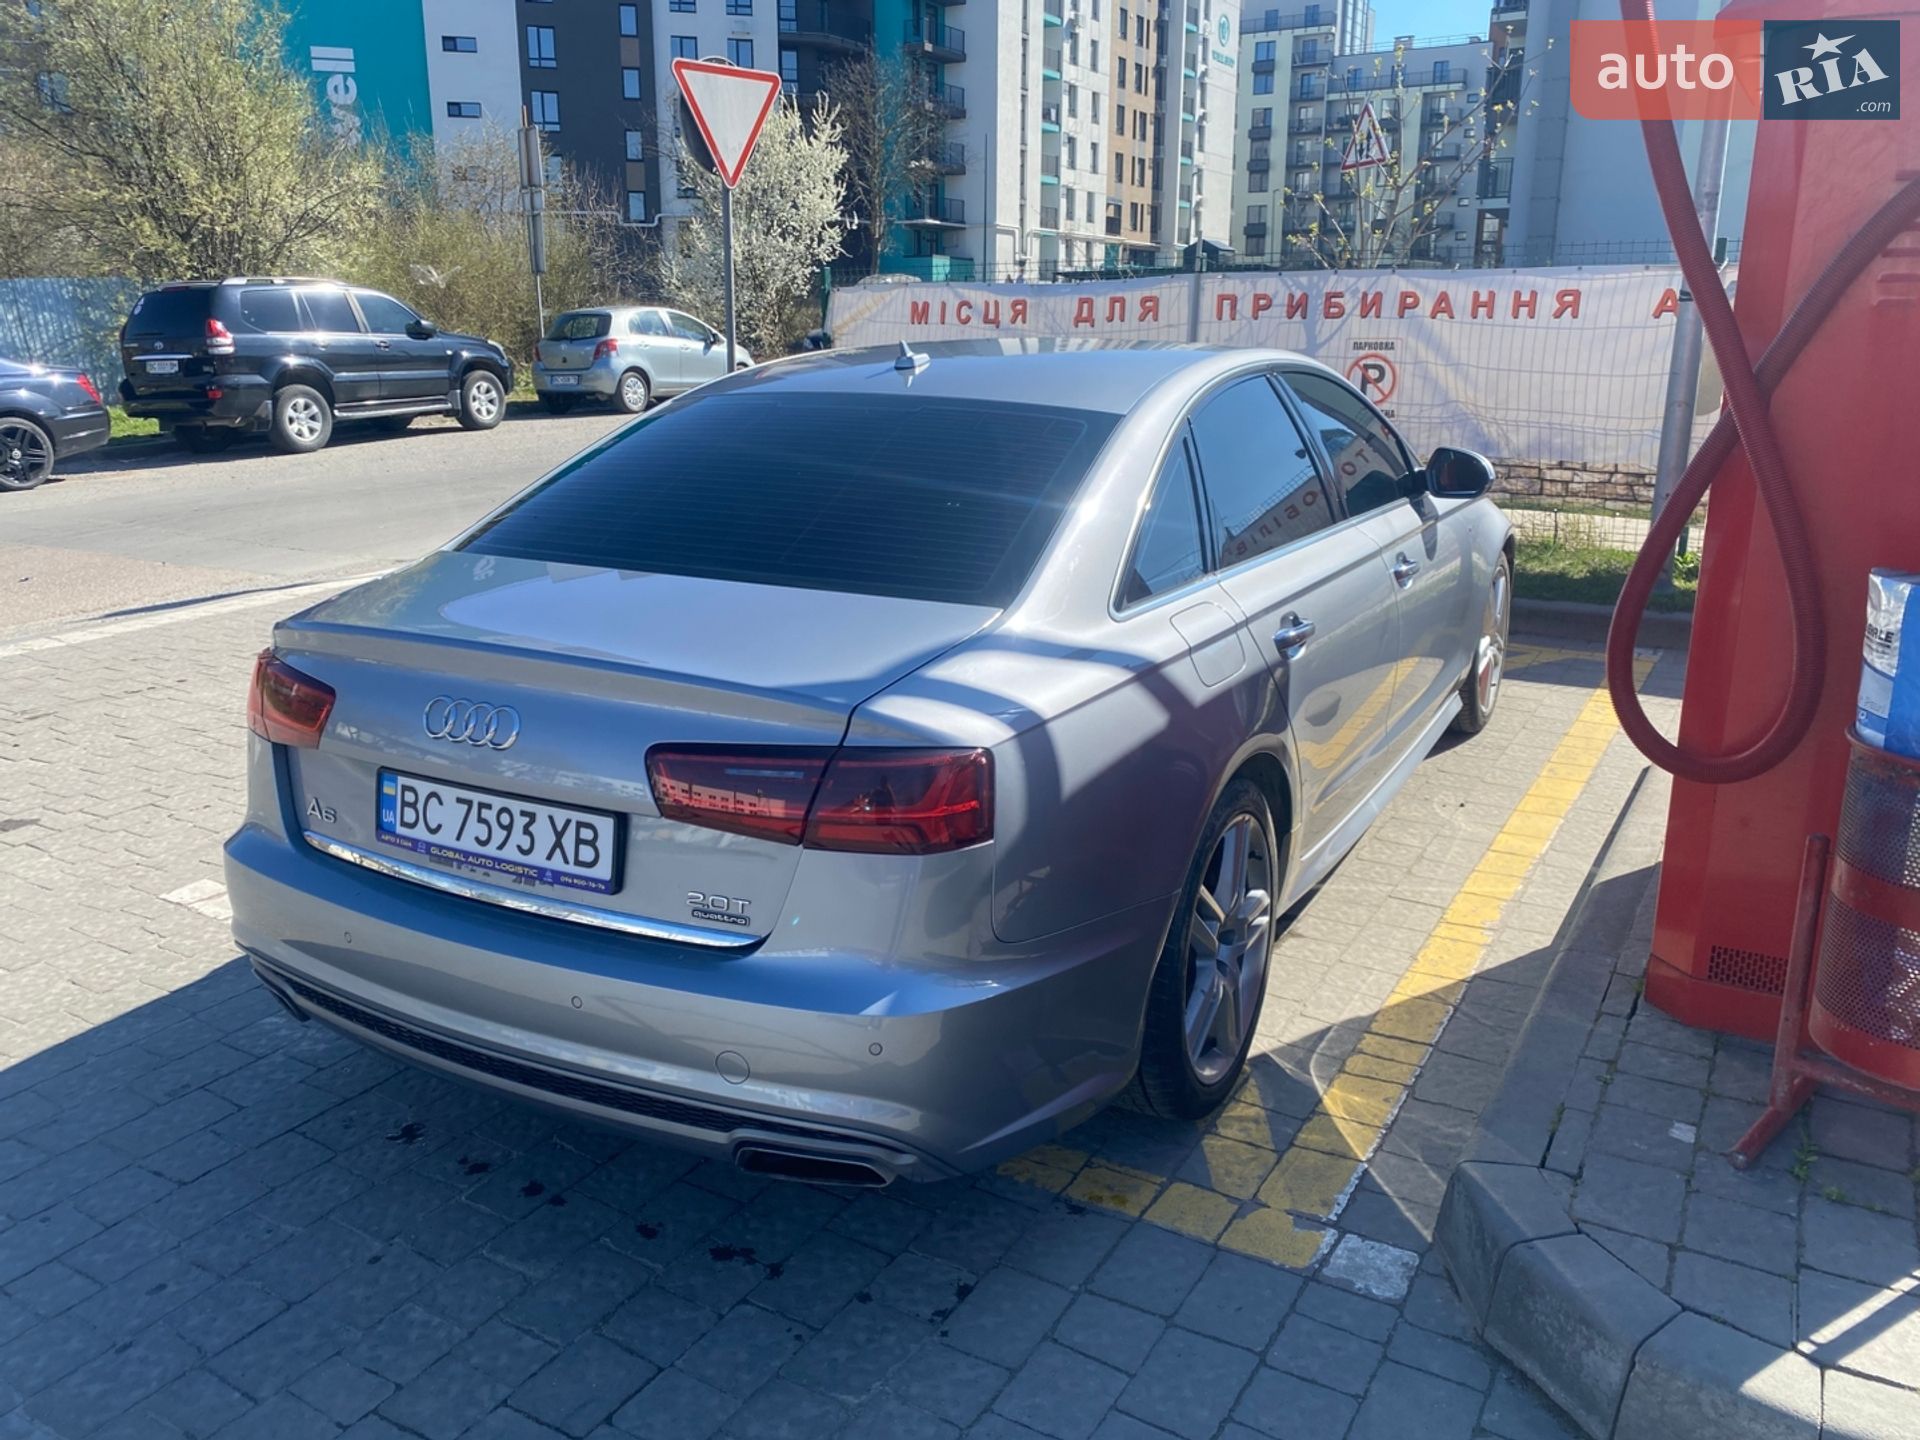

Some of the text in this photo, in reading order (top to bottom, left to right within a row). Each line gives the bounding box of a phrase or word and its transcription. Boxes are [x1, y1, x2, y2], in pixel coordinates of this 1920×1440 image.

[910, 299, 1028, 329] МІСЦЯ
[1073, 295, 1160, 328] ДЛЯ
[1215, 288, 1582, 321] ПРИБИРАННЯ
[306, 797, 337, 823] A6
[382, 808, 395, 824] UA
[400, 784, 600, 869] BC 7593 XB
[430, 846, 538, 877] GLOBAL AUTO LOGISTIC
[693, 910, 746, 925] quattro
